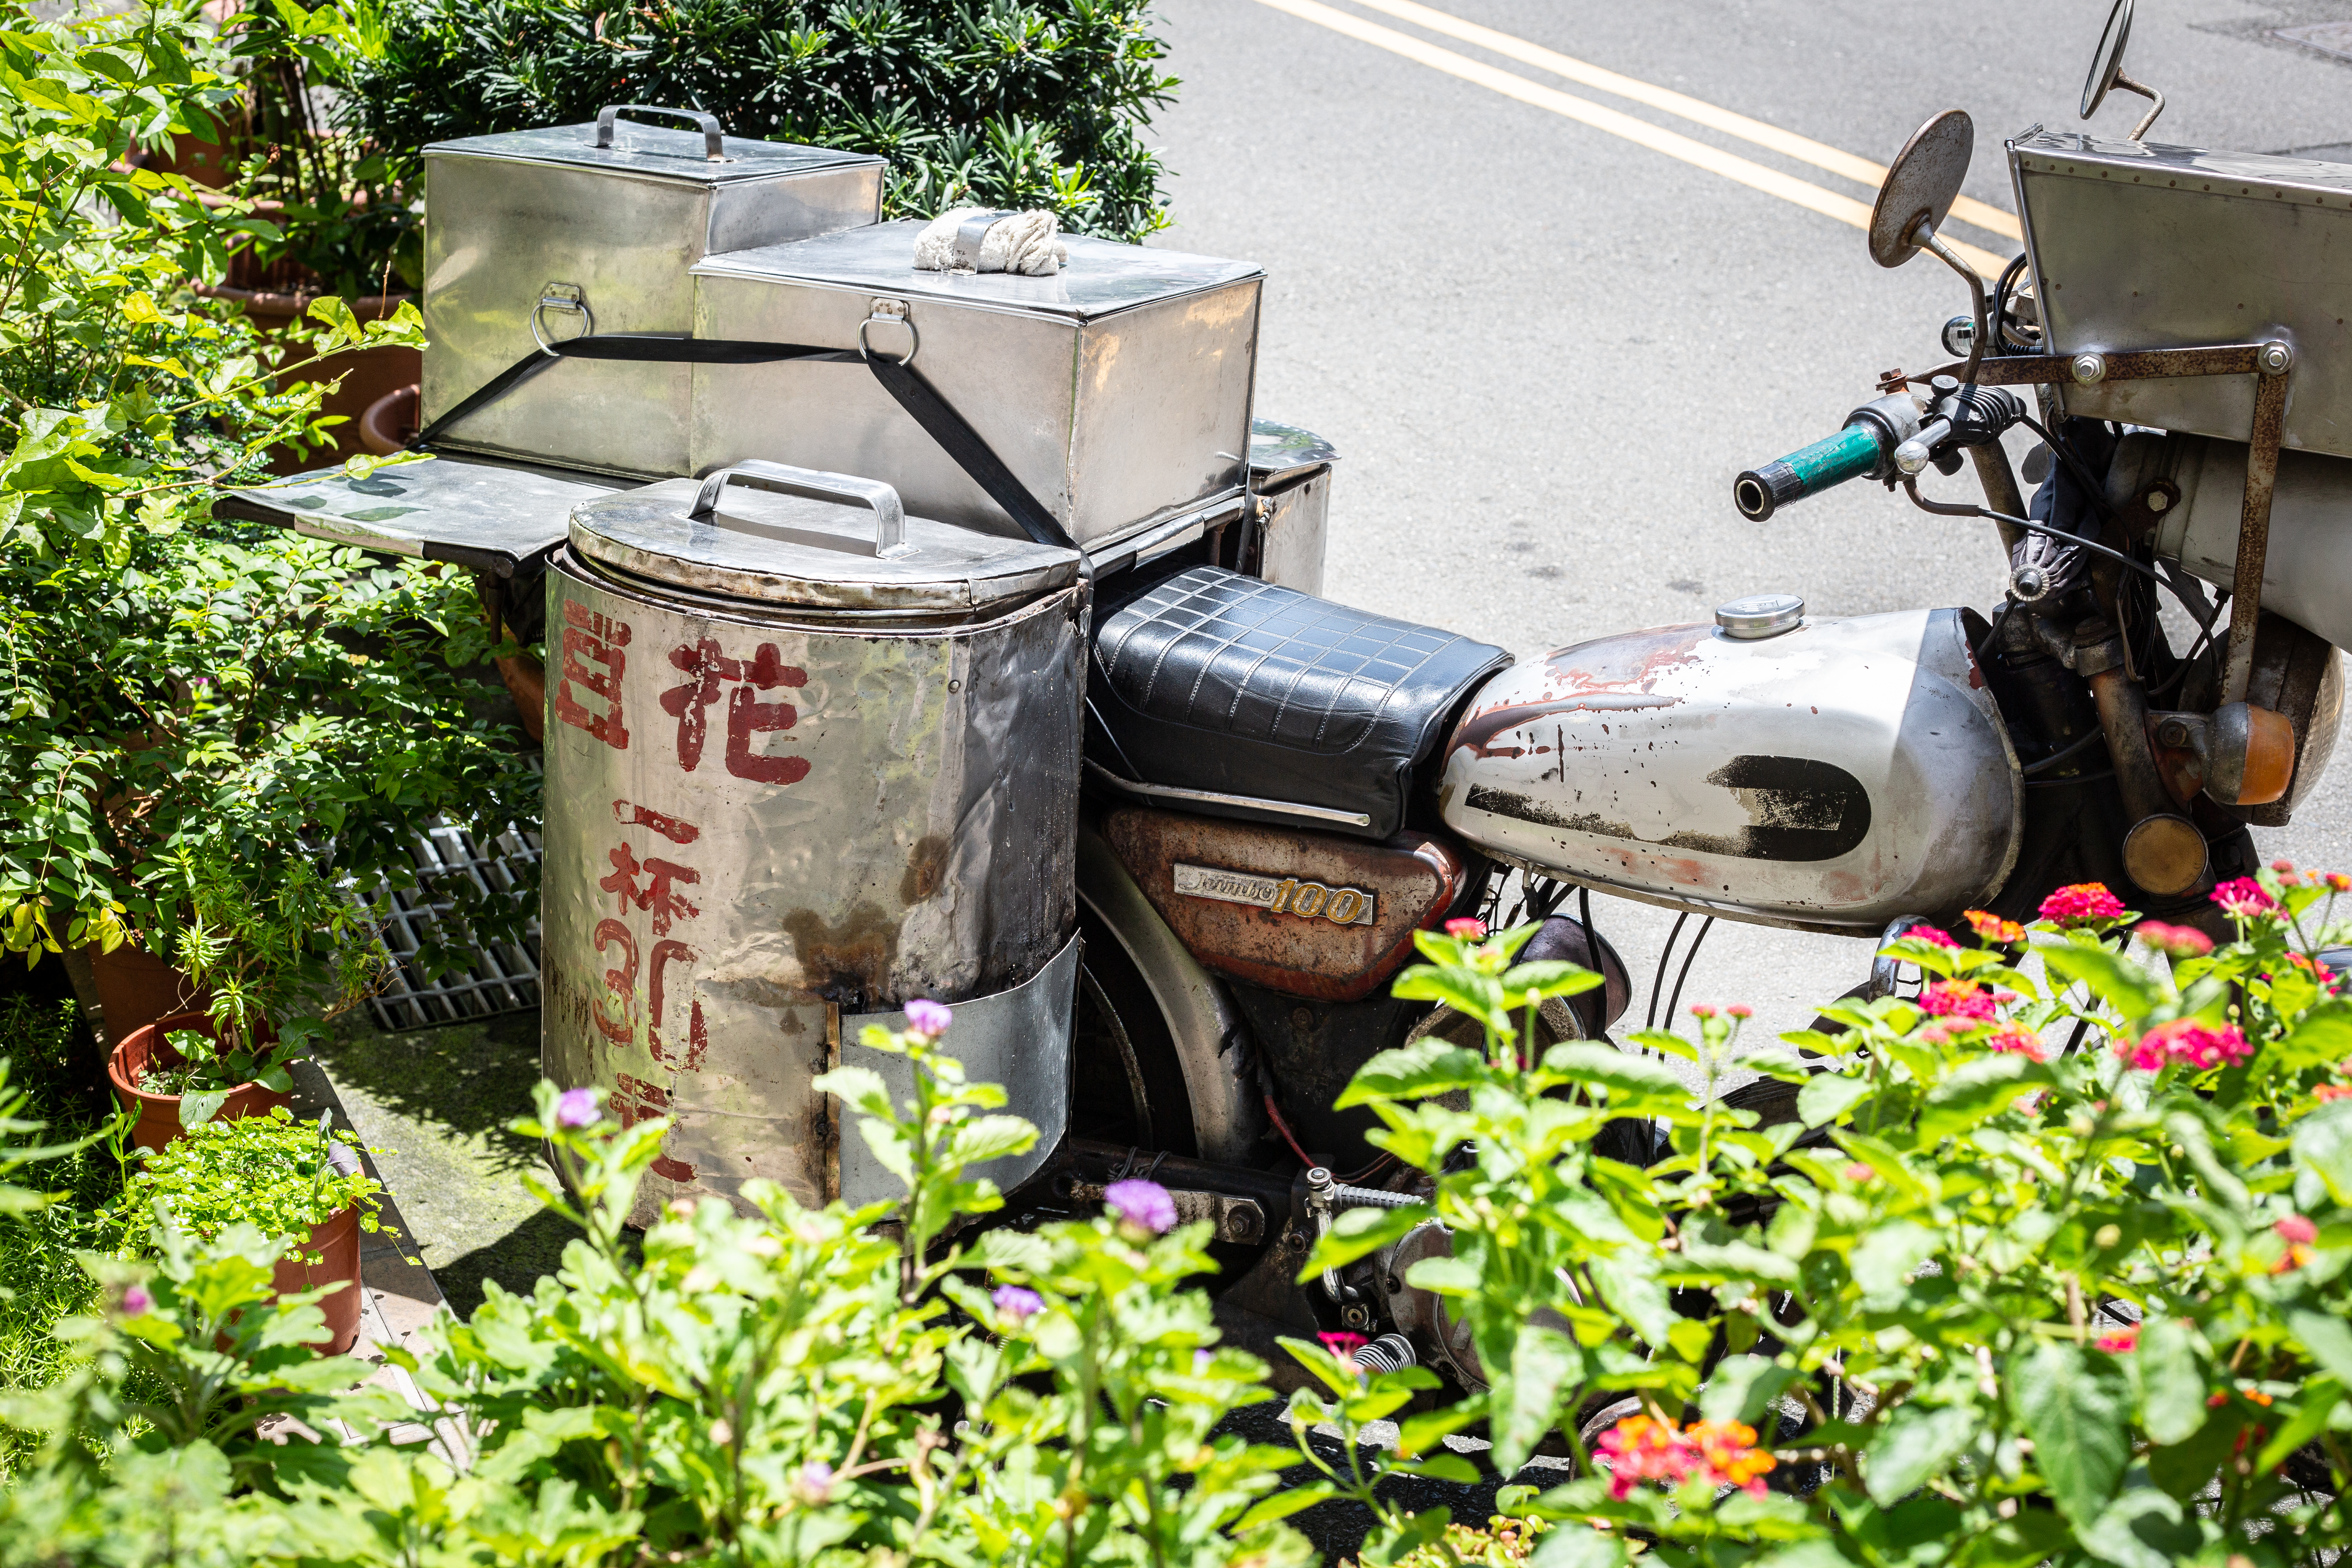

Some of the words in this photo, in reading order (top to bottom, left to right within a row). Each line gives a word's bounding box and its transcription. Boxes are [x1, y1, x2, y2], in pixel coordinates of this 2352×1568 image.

[556, 599, 812, 785] 豆花
[2305, 744, 2314, 764] TOP
[1178, 871, 1274, 901] Jumbo
[1271, 877, 1364, 924] 100
